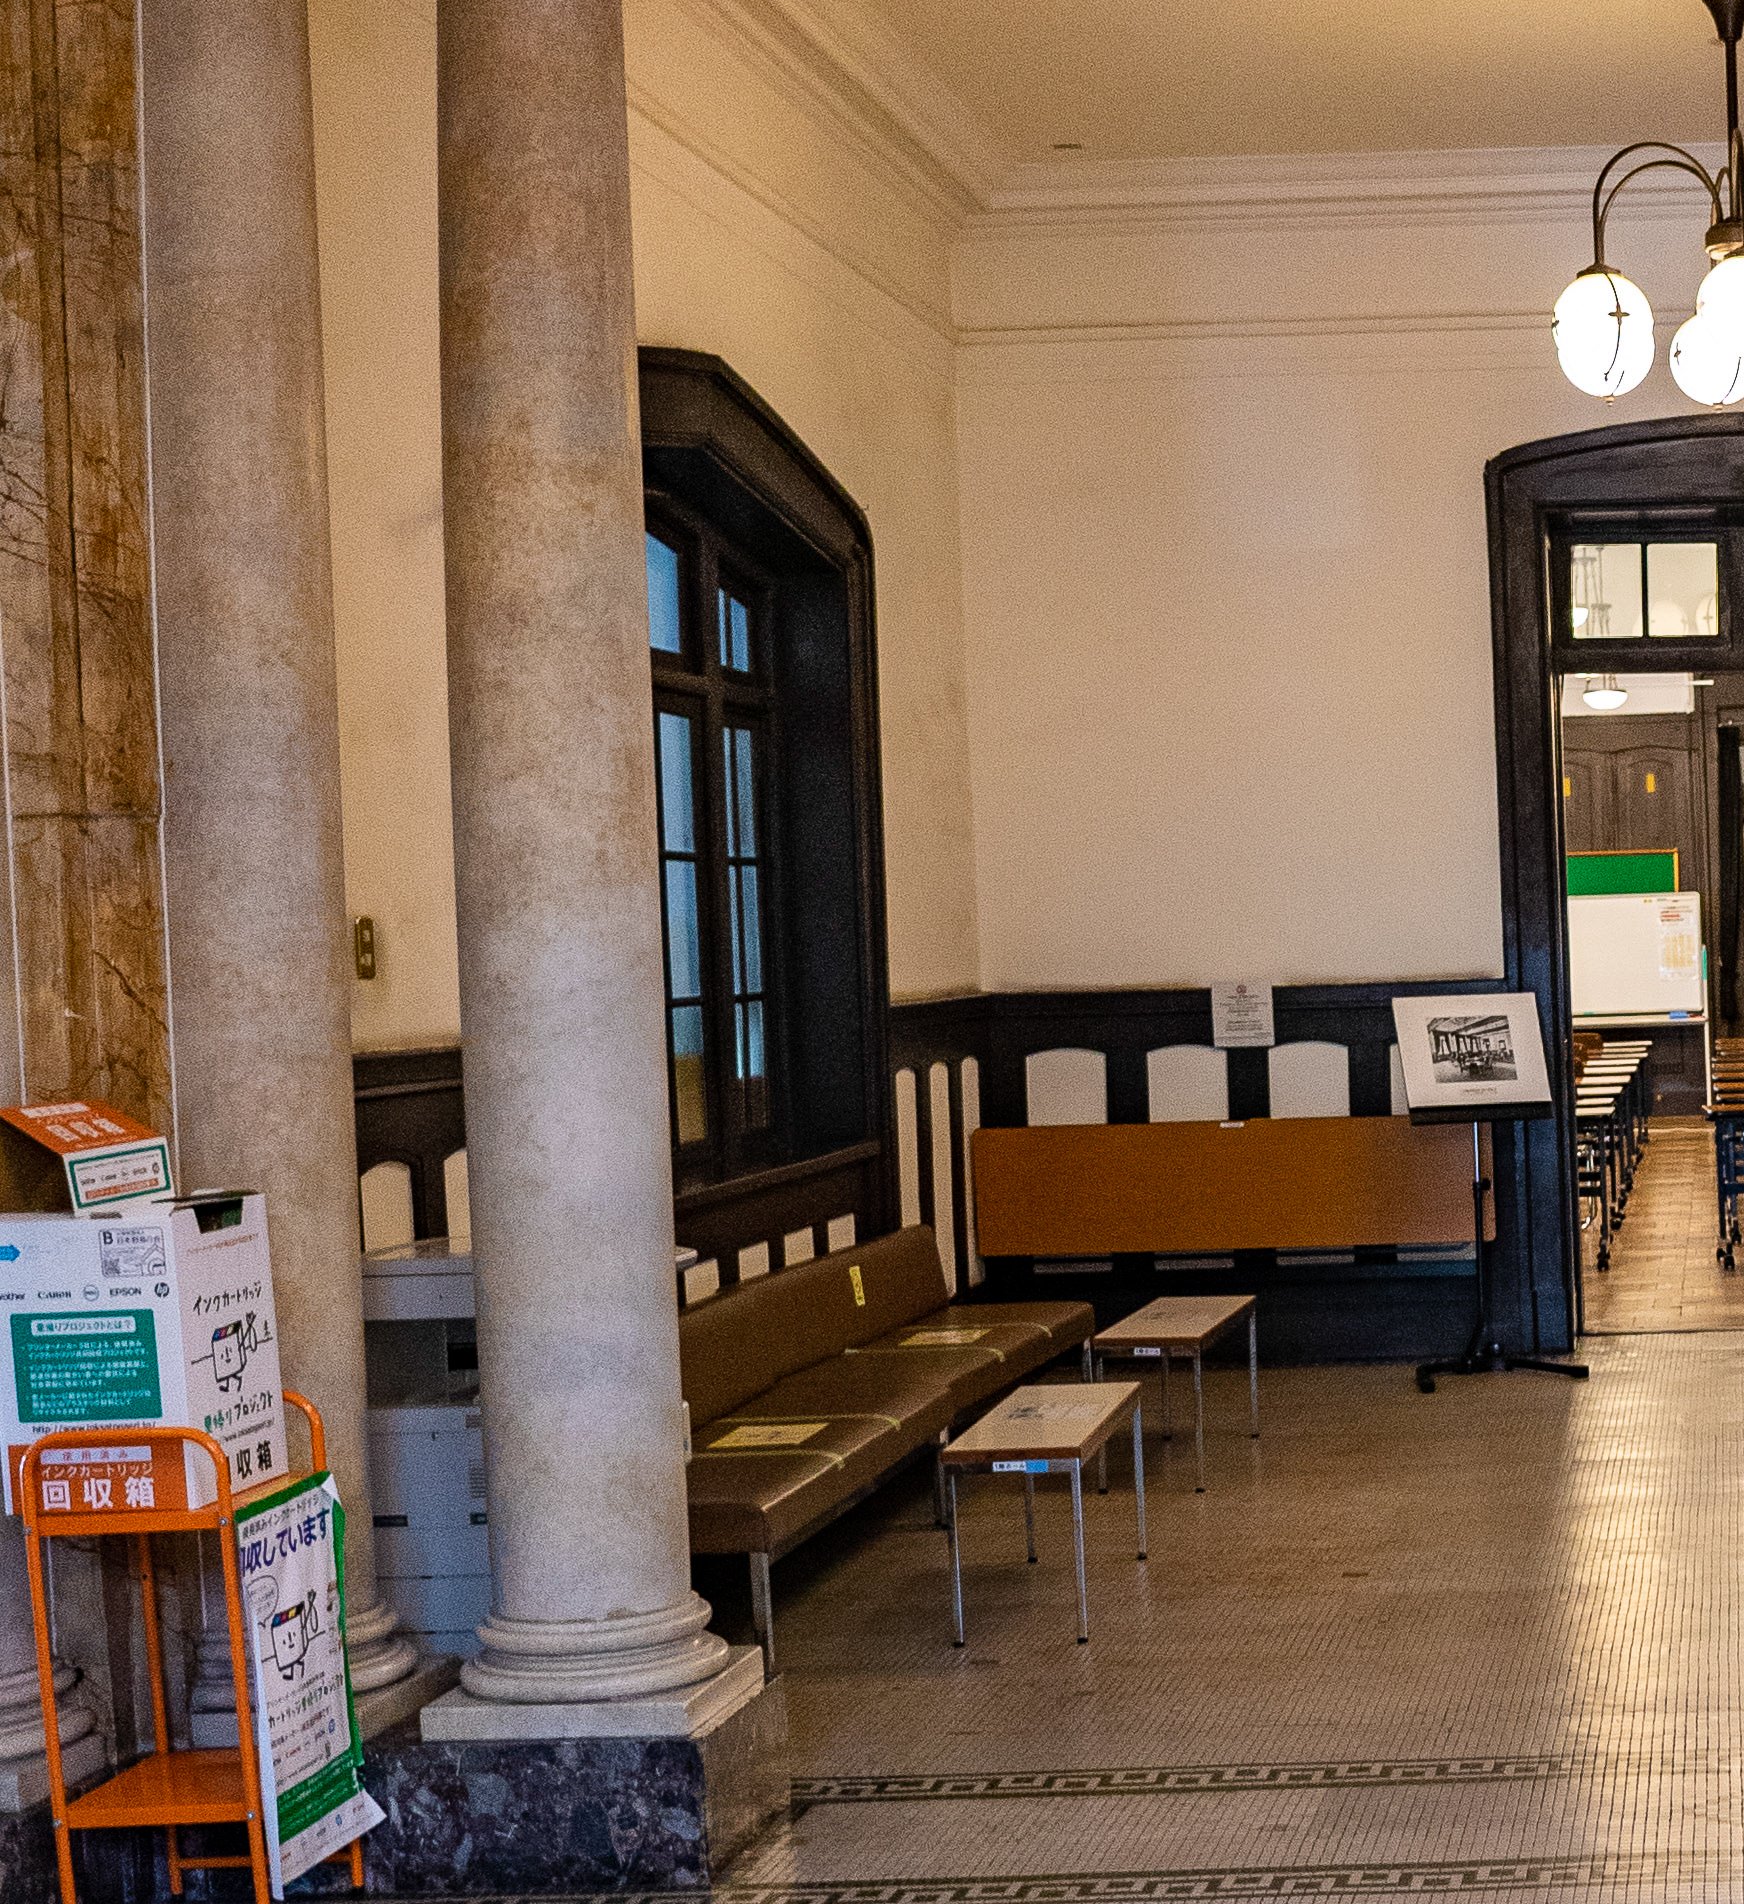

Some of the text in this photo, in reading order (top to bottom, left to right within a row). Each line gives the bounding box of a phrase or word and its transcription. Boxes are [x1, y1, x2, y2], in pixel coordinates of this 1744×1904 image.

[109, 1287, 142, 1297] EPSON
[42, 1462, 154, 1479] インクカートリッジ
[235, 1439, 273, 1480] 収箱
[41, 1476, 156, 1511] 回収箱
